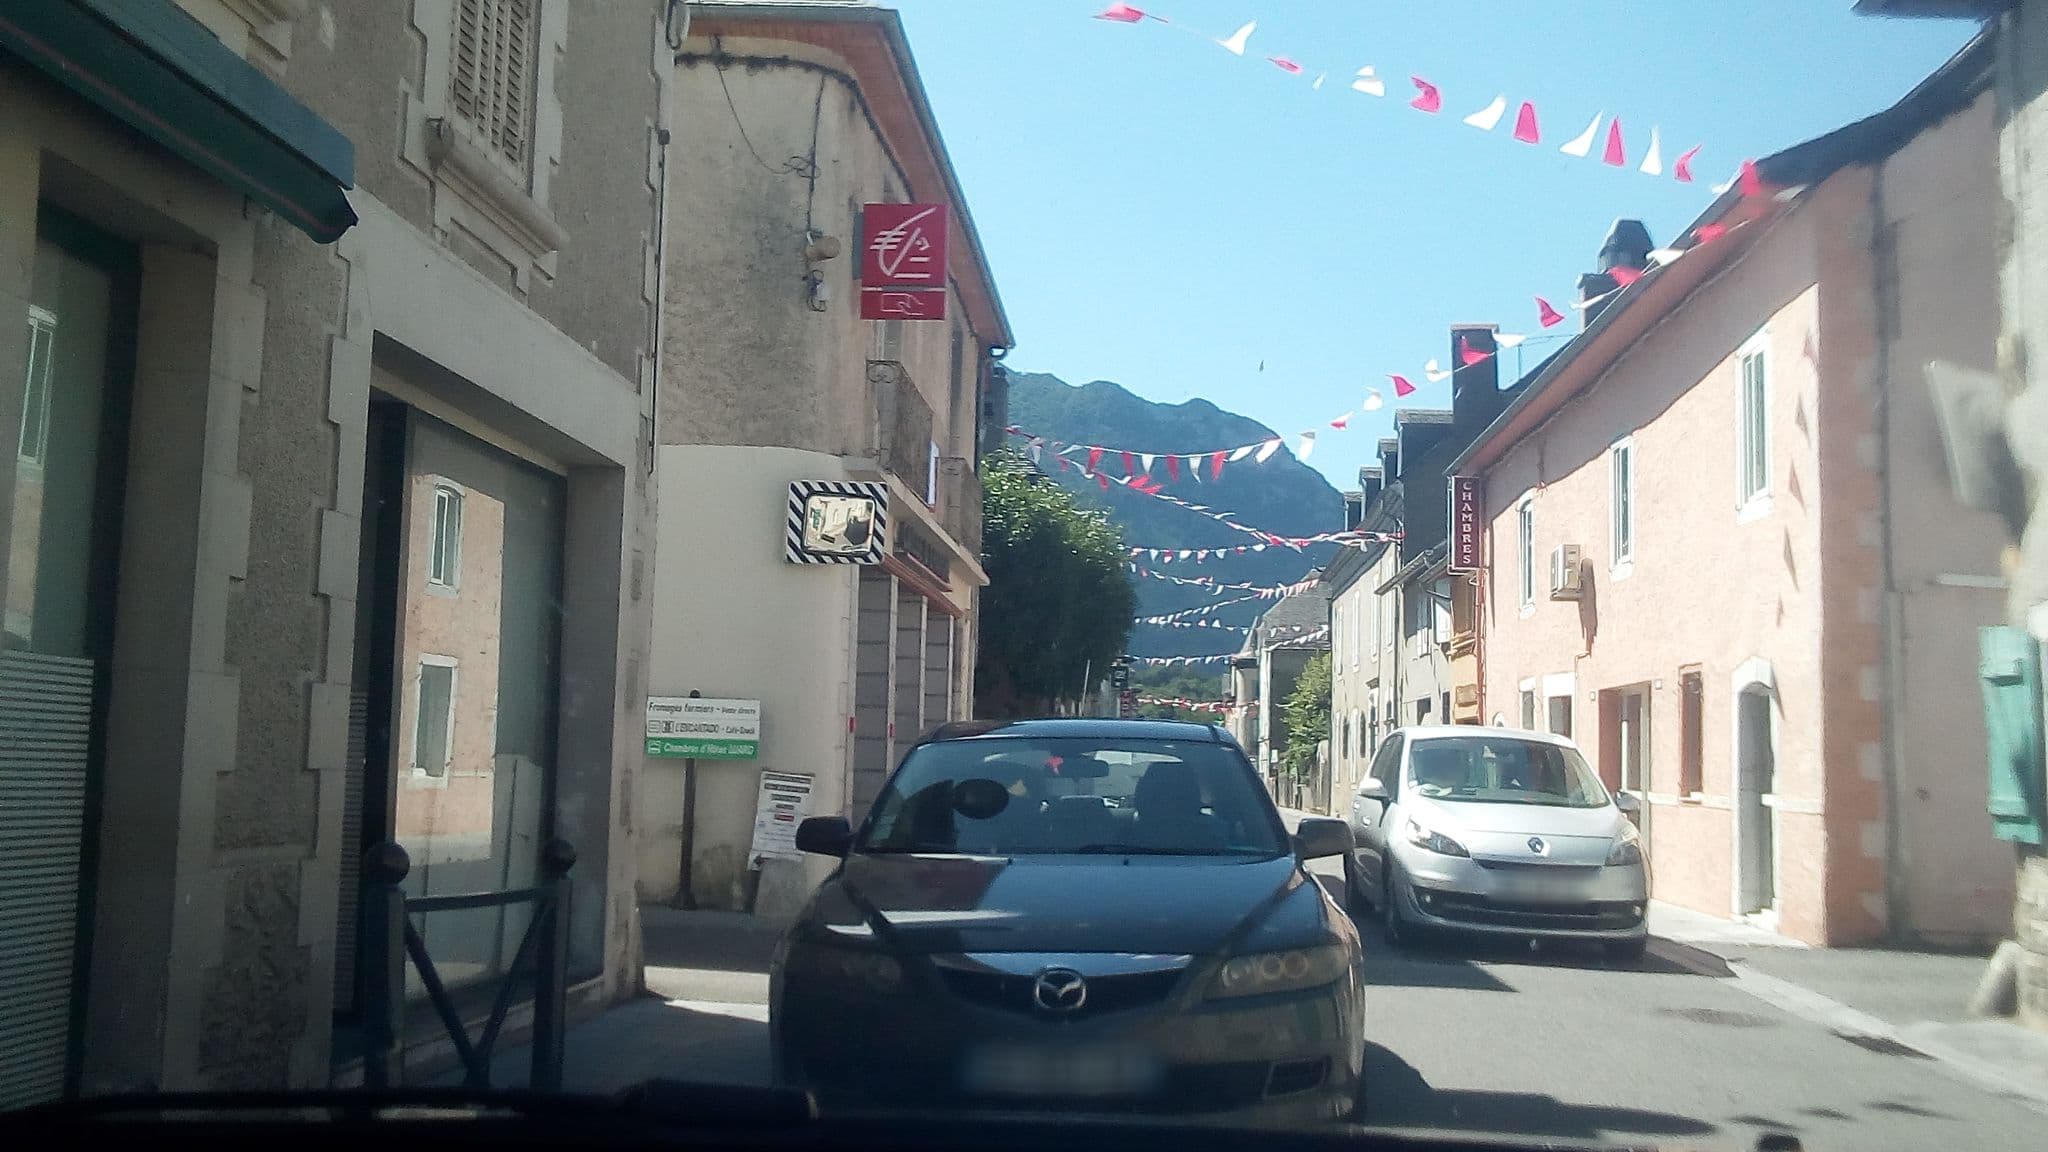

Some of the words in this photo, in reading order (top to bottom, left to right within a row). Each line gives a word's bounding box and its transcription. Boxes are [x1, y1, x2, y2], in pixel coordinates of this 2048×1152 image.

[1462, 481, 1473, 564] CHAMBRES
[648, 702, 682, 715] Fromages
[684, 703, 714, 713] fermiers
[663, 742, 699, 753] Chambres
